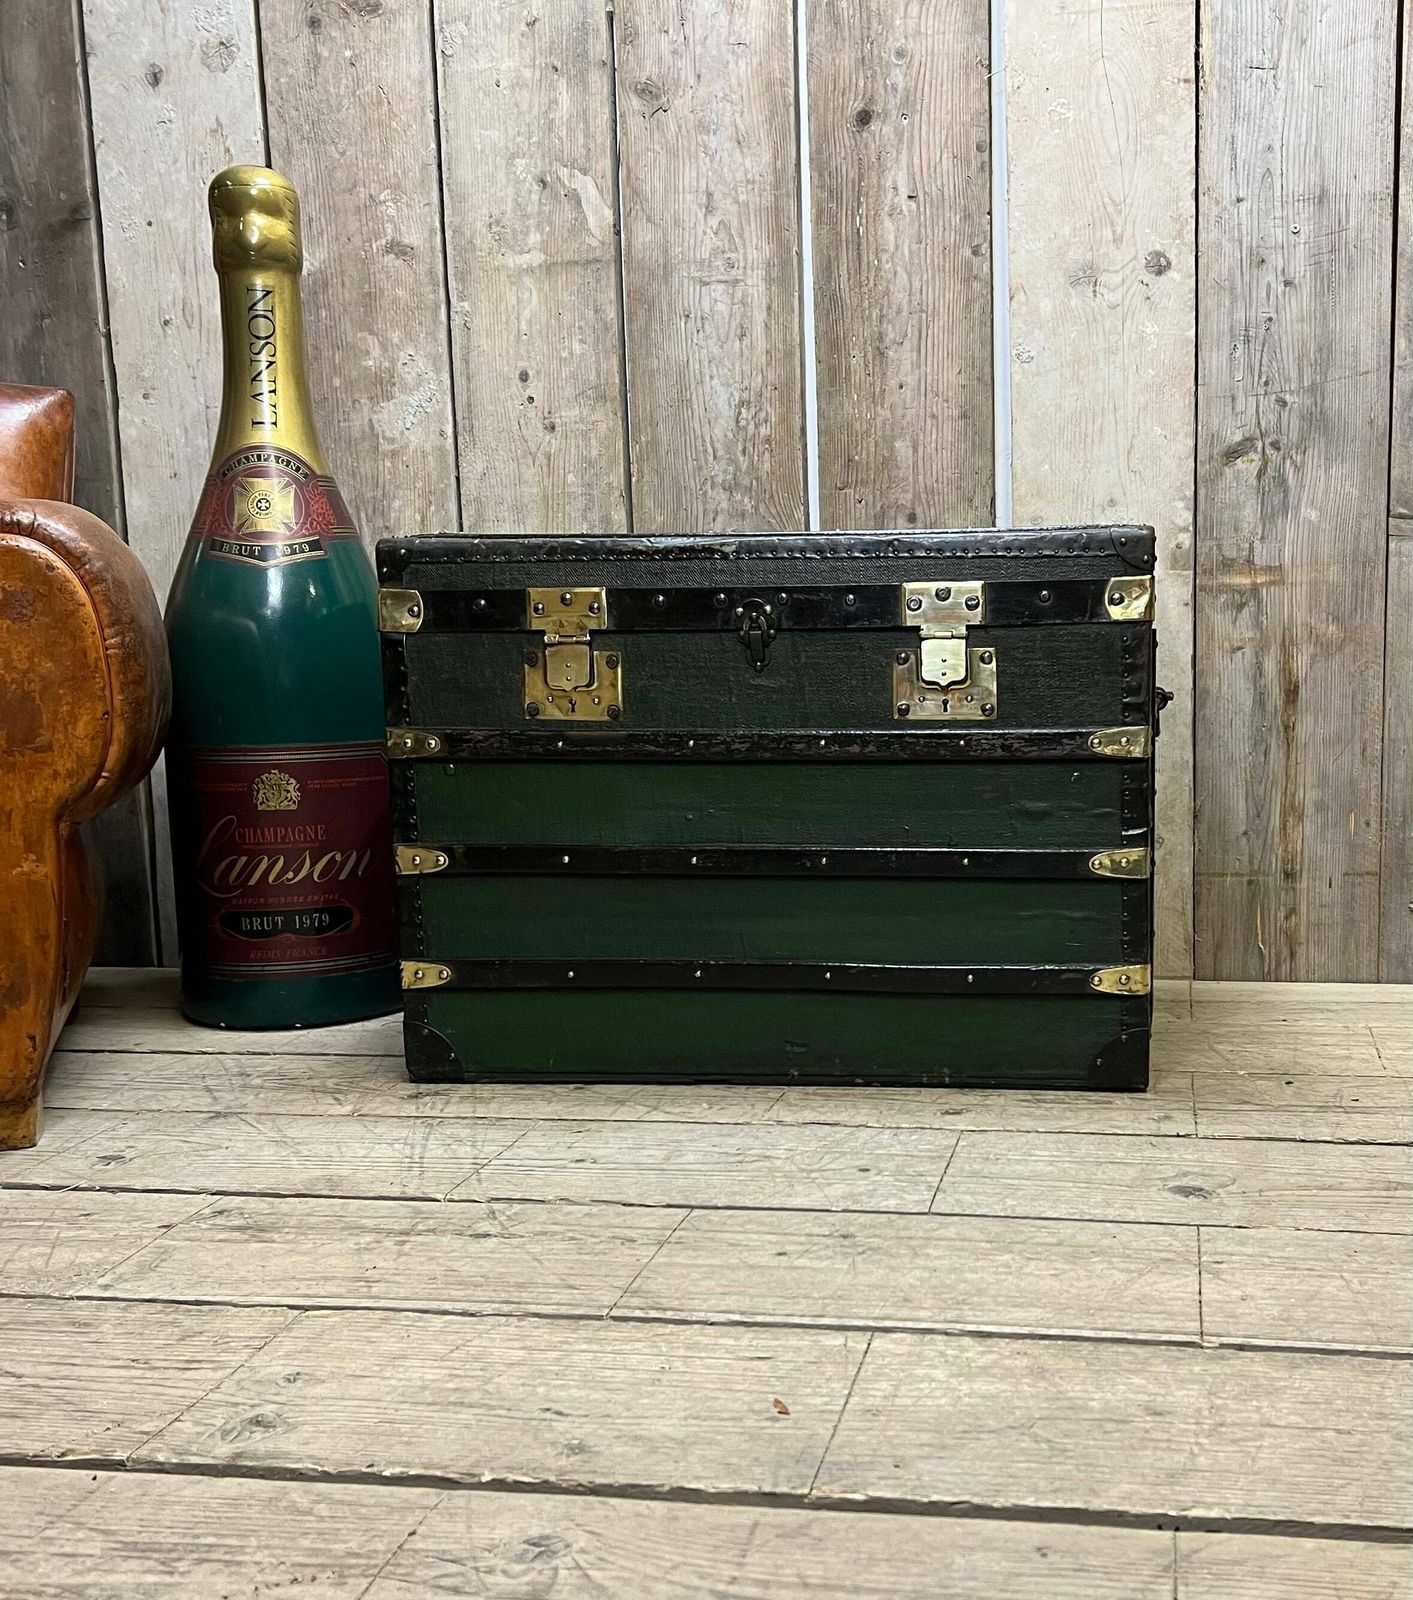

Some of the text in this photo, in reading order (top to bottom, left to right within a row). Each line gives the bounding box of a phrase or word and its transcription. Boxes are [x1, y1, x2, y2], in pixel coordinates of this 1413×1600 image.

[246, 287, 278, 429] LANSON
[224, 453, 305, 477] CHAMPAGNE
[222, 543, 310, 557] BRUT 1979
[235, 824, 326, 843] CHAMPAGNE
[195, 815, 374, 897] Lanson
[241, 912, 329, 931] BRUT 1979
